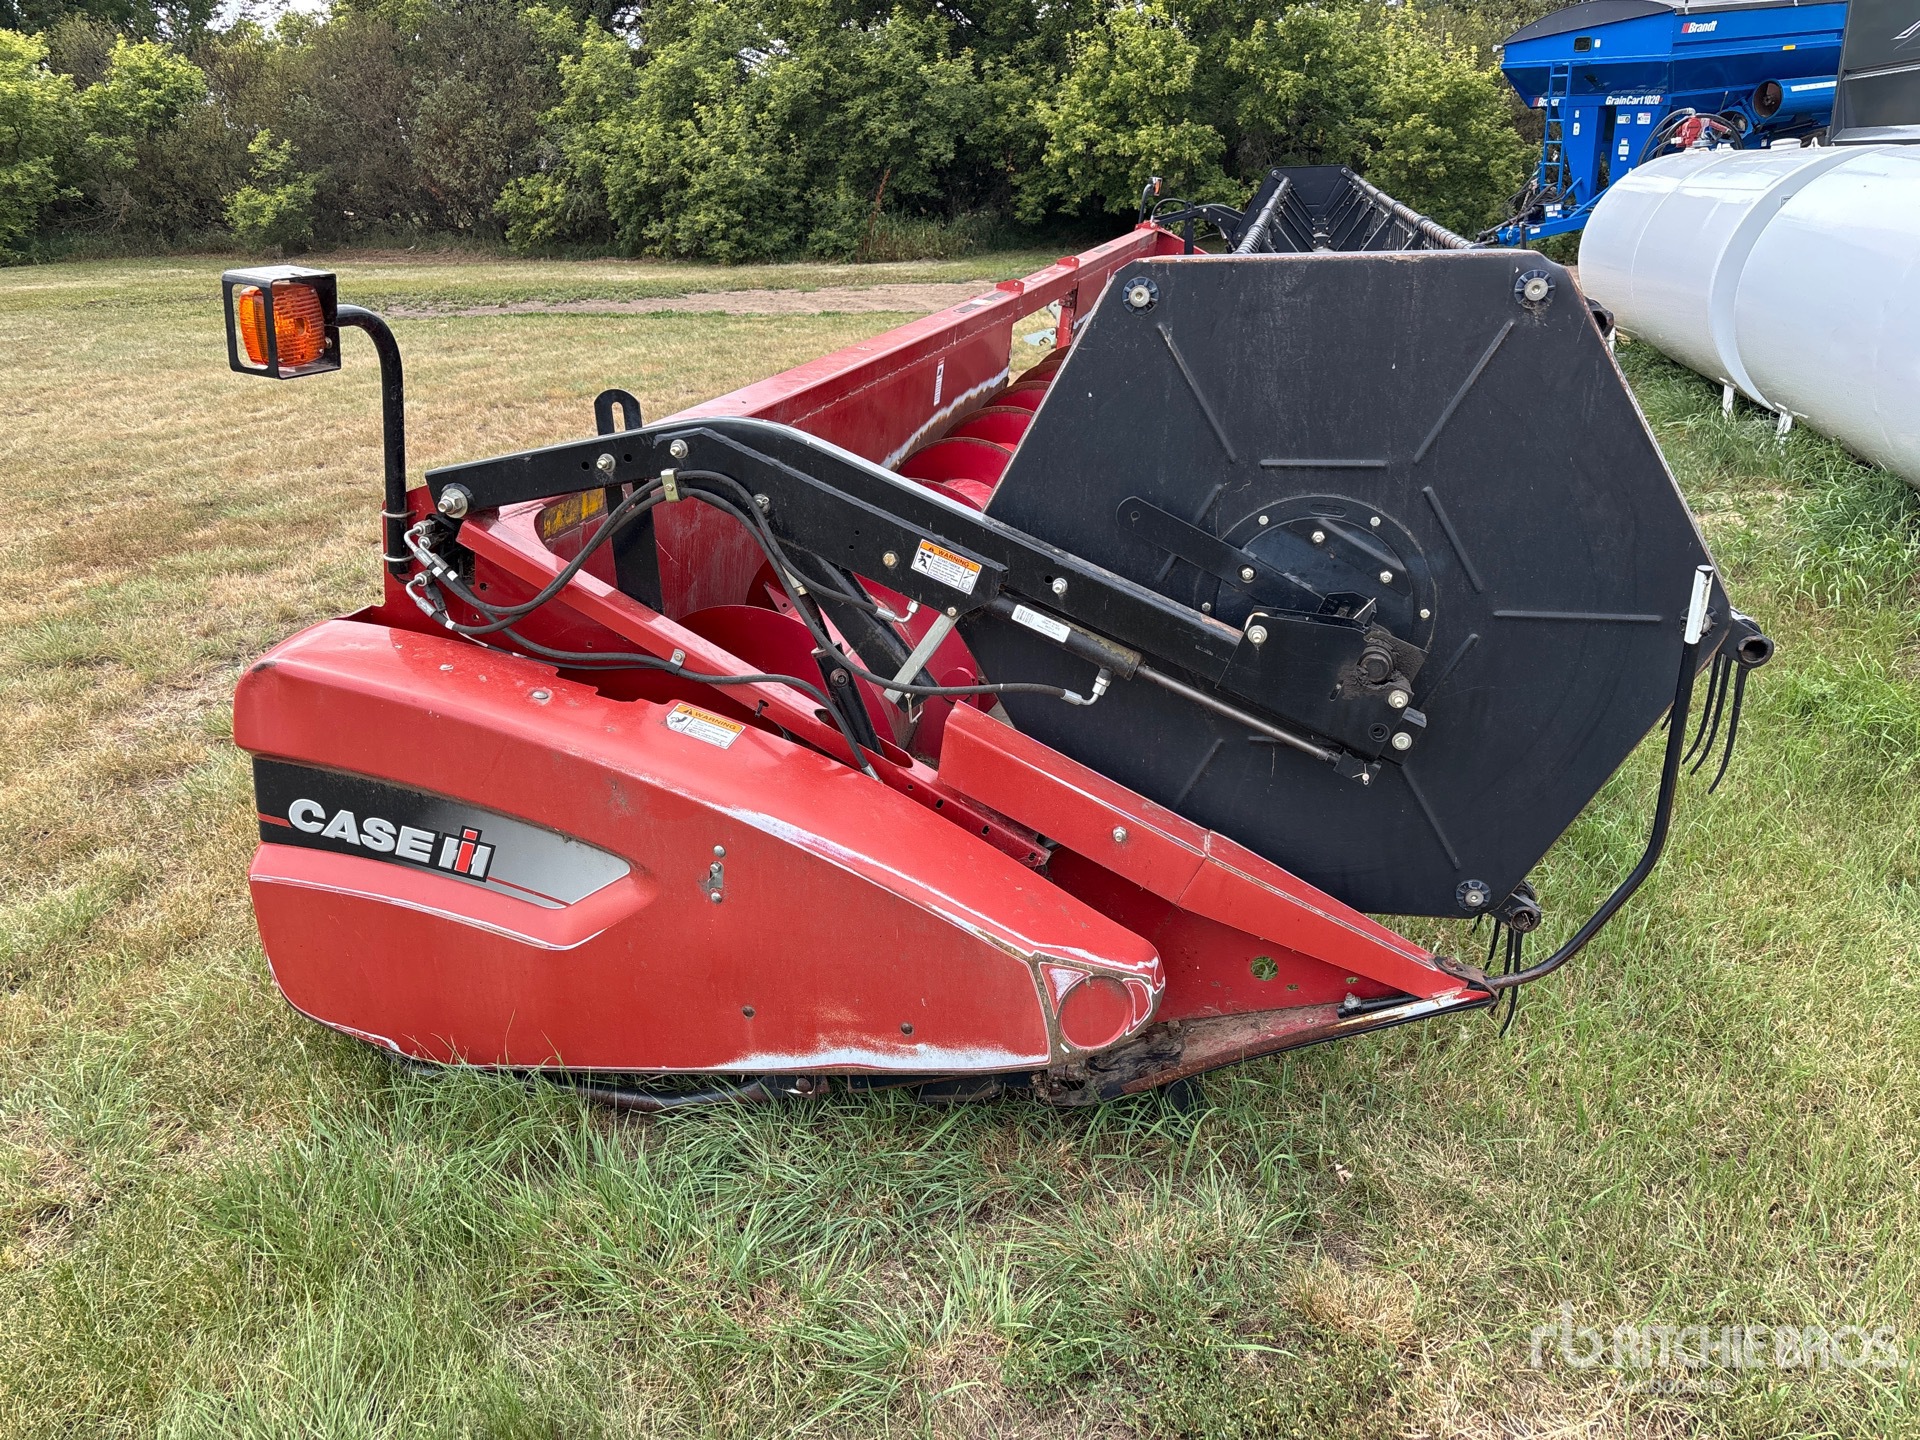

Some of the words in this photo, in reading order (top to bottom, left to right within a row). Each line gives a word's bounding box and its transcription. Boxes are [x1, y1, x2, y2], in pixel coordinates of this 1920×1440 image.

[1688, 20, 1718, 33] Brandt
[938, 549, 970, 568] WARNING
[695, 711, 737, 730] WARNING
[288, 798, 437, 864] CASE
